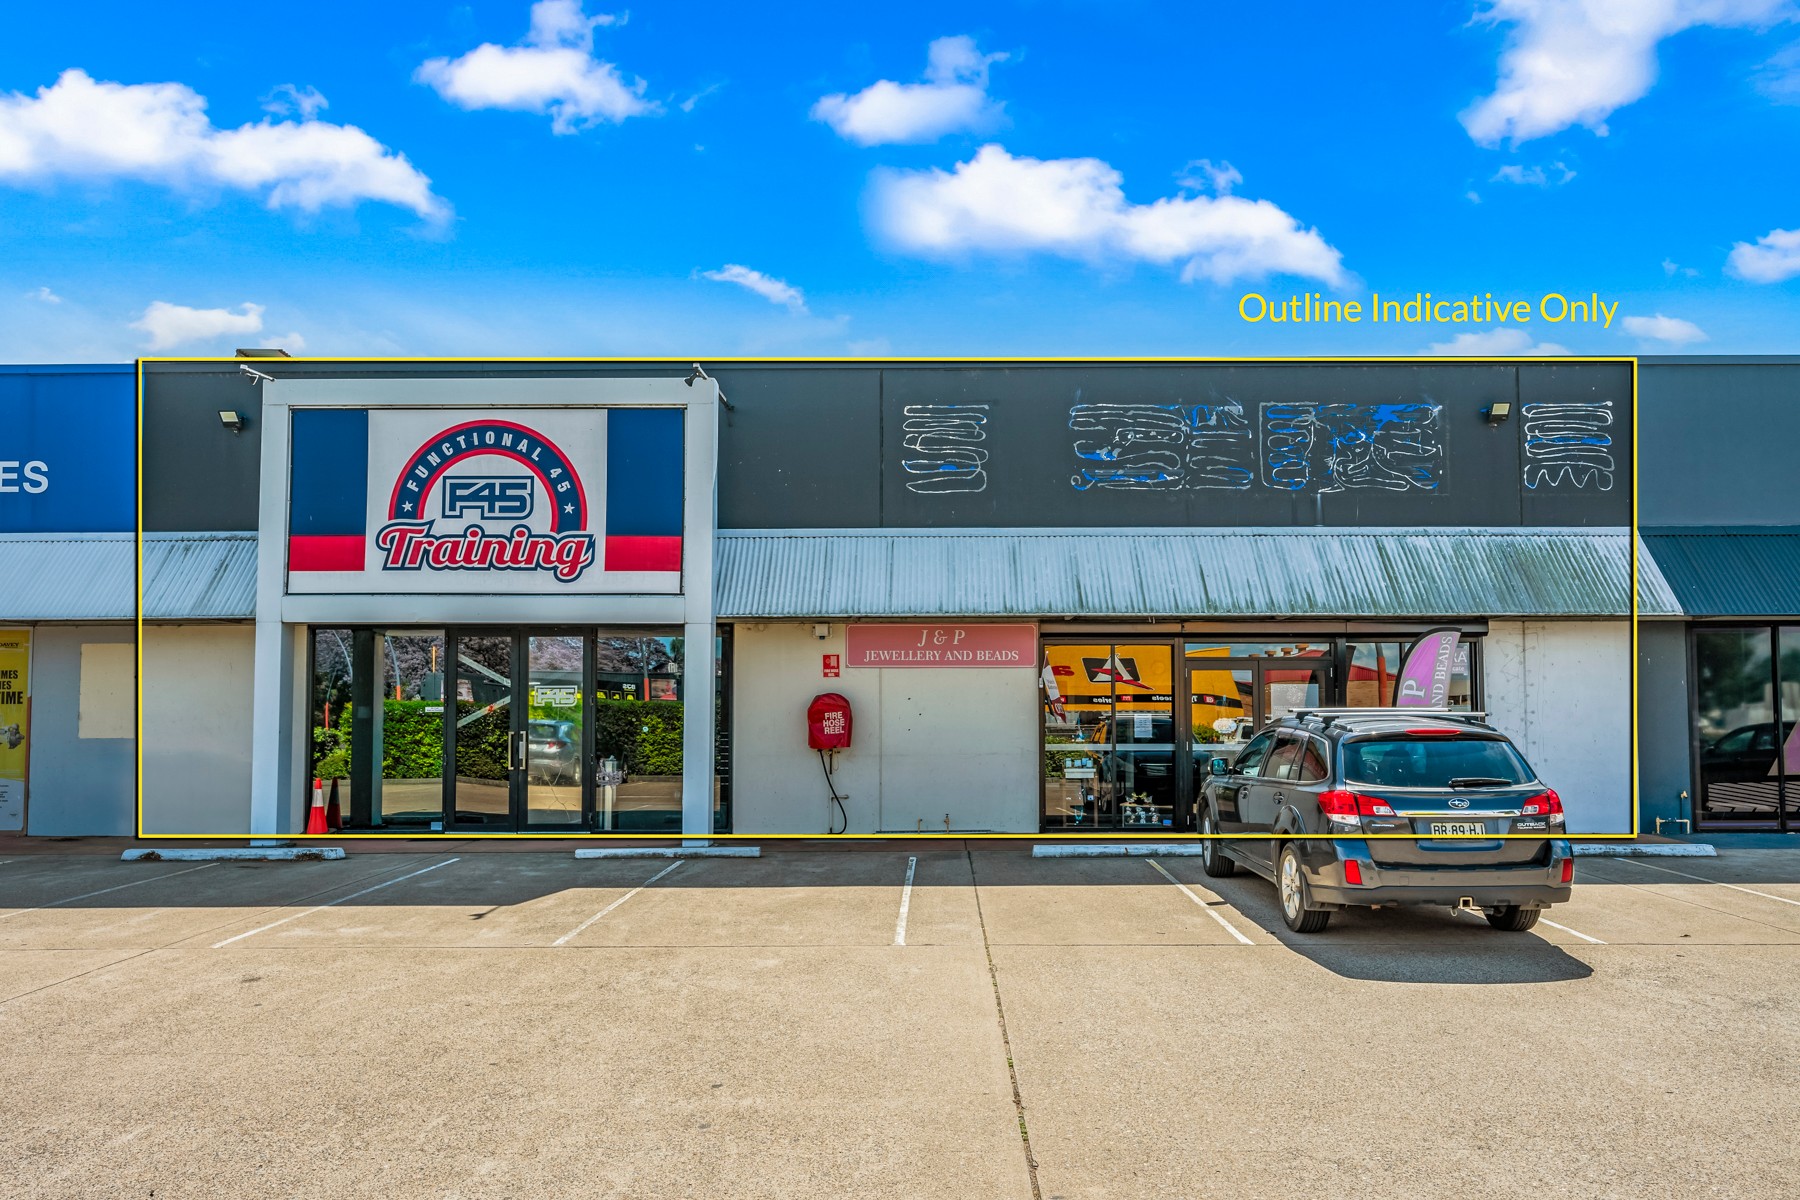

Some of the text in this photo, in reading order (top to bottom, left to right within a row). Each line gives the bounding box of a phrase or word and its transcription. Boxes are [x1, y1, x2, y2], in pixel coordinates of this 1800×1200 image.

[406, 431, 571, 494] FUNCTIONAL 45
[442, 475, 535, 520] F45
[376, 519, 596, 583] Training
[917, 630, 966, 647] J & P
[864, 650, 1019, 662] JEWELLERY AND BEADS
[1435, 636, 1452, 680] BEADS
[534, 685, 578, 707] F45
[1402, 679, 1425, 698] P
[822, 718, 845, 728] HOSE
[824, 711, 843, 720] FIRE
[824, 725, 845, 735] REEL
